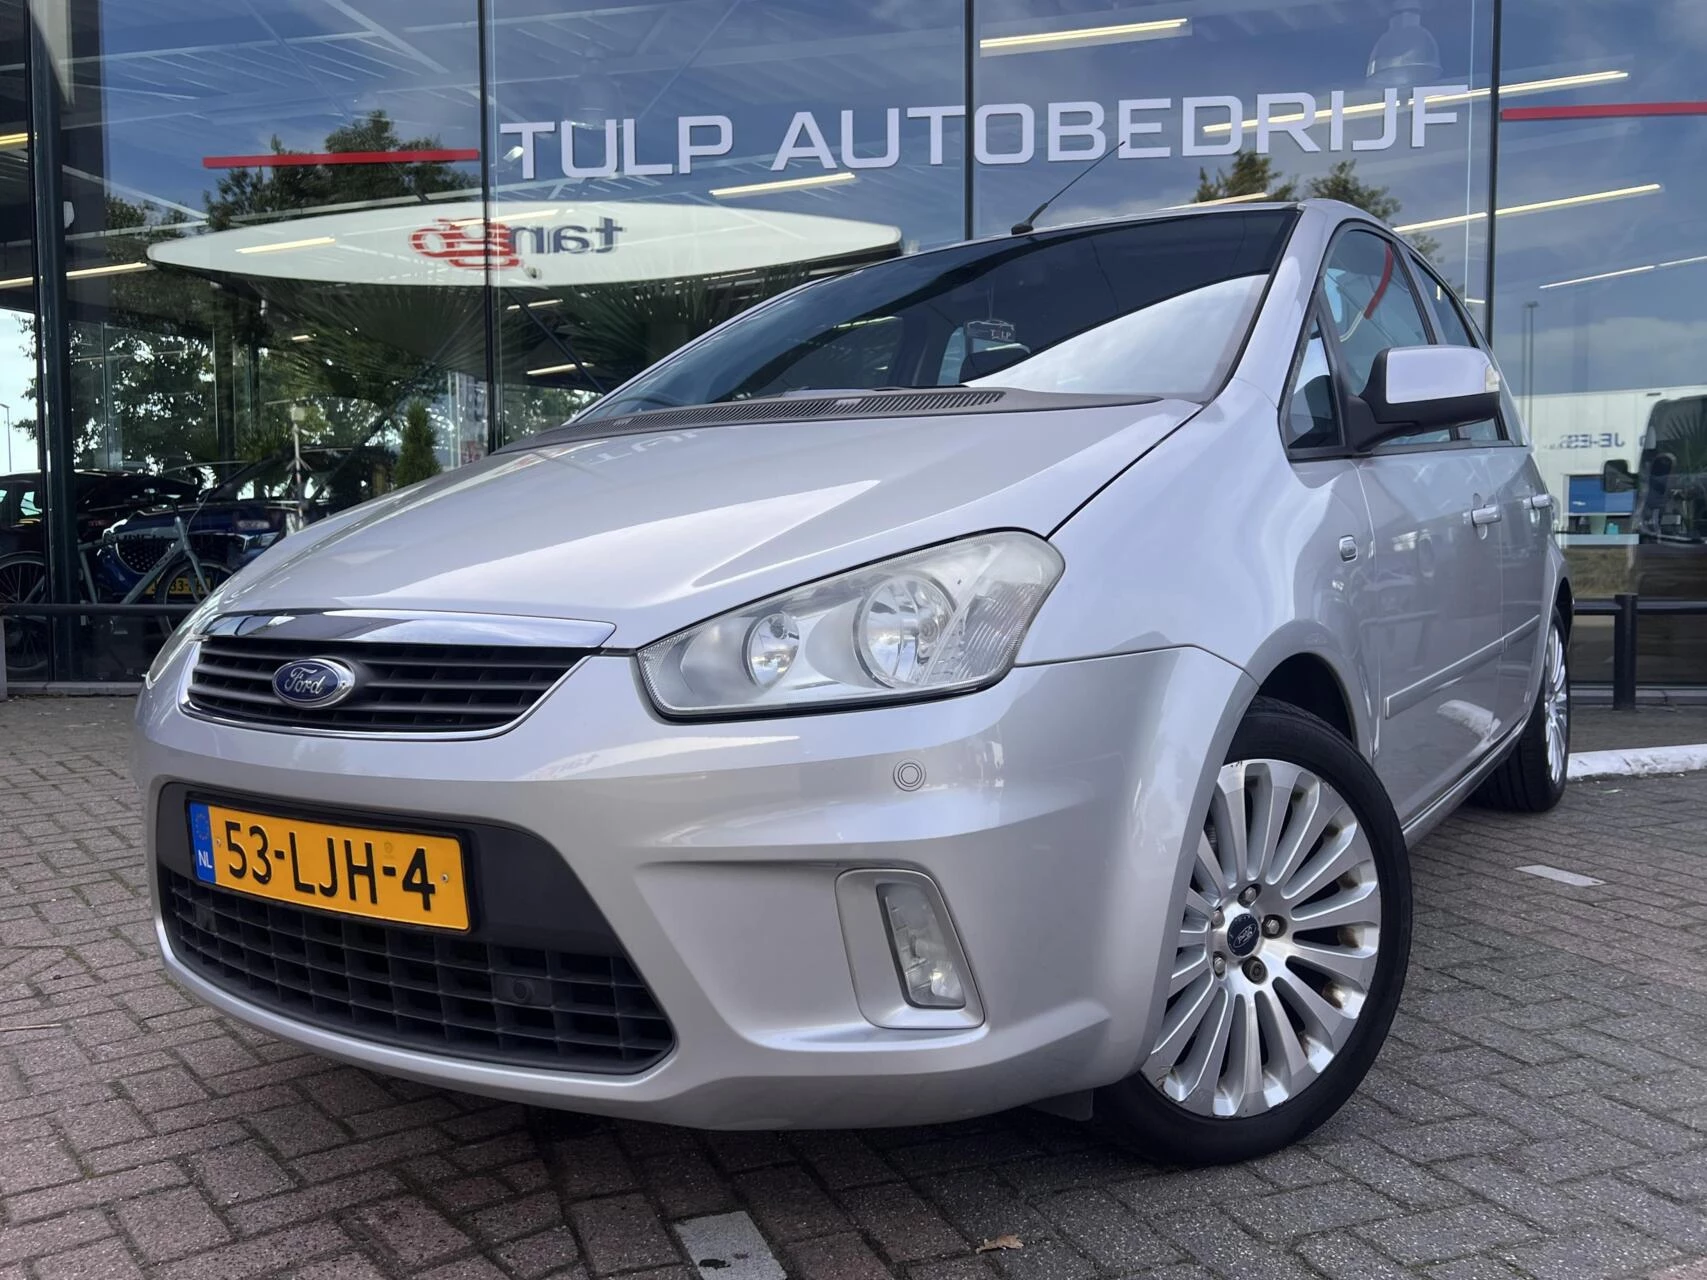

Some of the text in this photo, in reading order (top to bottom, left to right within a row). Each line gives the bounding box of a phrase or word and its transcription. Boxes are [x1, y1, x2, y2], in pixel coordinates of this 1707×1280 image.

[499, 84, 1469, 180] TULP AUTOBEDRIJF
[284, 666, 327, 695] Ford
[198, 849, 213, 869] NL
[225, 820, 436, 912] 53-LJH-4
